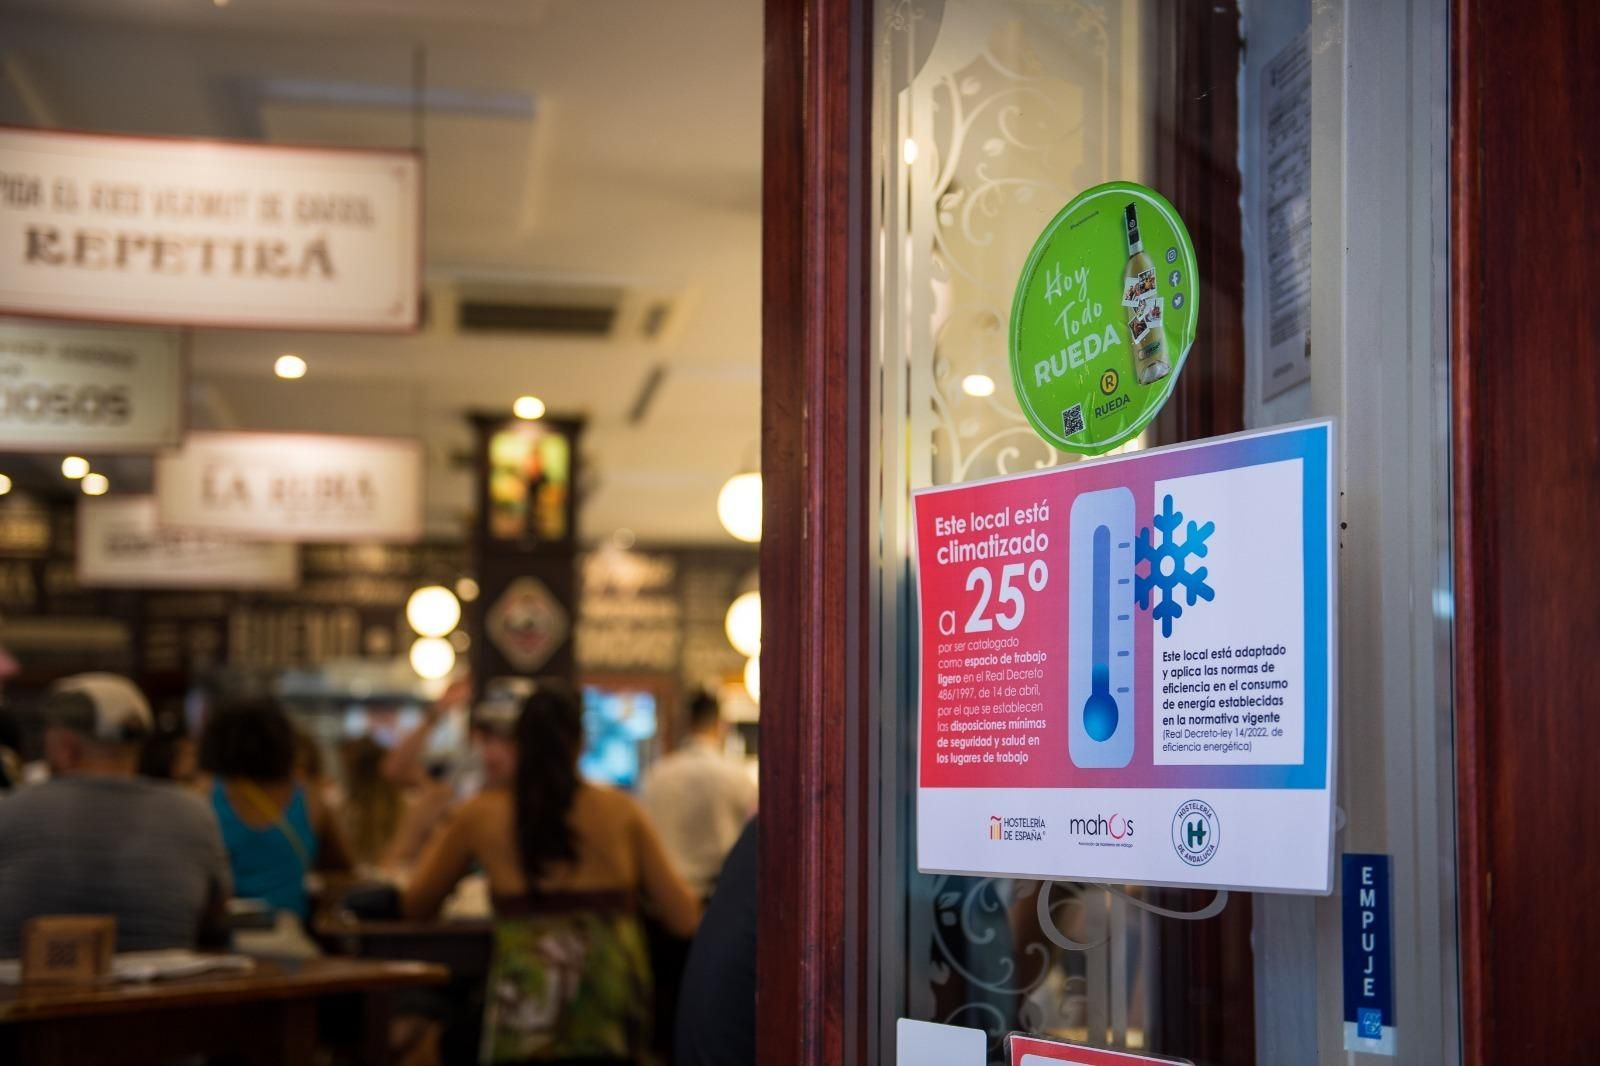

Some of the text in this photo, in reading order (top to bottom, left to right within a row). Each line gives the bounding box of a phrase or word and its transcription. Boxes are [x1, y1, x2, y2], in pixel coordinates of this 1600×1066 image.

[1044, 261, 1090, 304] Hoy
[1054, 298, 1103, 340] Todo
[1033, 324, 1122, 388] RUEDA
[1094, 393, 1131, 418] RUEDA
[935, 498, 1050, 537] Este local está
[937, 528, 1049, 565] climatizado
[939, 610, 956, 636] a
[938, 637, 1019, 654] por ser catalogado
[1162, 643, 1287, 662] Este local está adaptado
[938, 651, 1047, 668] como espacio de trabajo
[938, 668, 1044, 687] ligero en el Real Decreto
[1162, 661, 1275, 680] y aplica las normas de
[979, 688, 990, 698] de
[993, 687, 1002, 697] 14
[1005, 686, 1017, 696] de
[1162, 679, 1288, 694] eficiencia en el consumo
[938, 702, 1043, 717] por el que se establecen
[1162, 694, 1284, 711] de energía establecidas
[937, 716, 1046, 733] las disposiciones mínimas
[1162, 711, 1281, 726] en la normativa vigente
[937, 735, 1040, 749] de seguridad y salud en
[1162, 729, 1182, 741] (Real
[1184, 728, 1232, 740] Decreto-ley
[1271, 726, 1283, 737] de
[1162, 741, 1252, 753] eficiencia energética)
[936, 751, 1029, 765] los lugares de trabajo
[1003, 815, 1046, 828] HOSTELERÍA
[1003, 830, 1013, 841] DE
[1177, 844, 1186, 855] DE
[1359, 866, 1376, 997] EMPUJE
